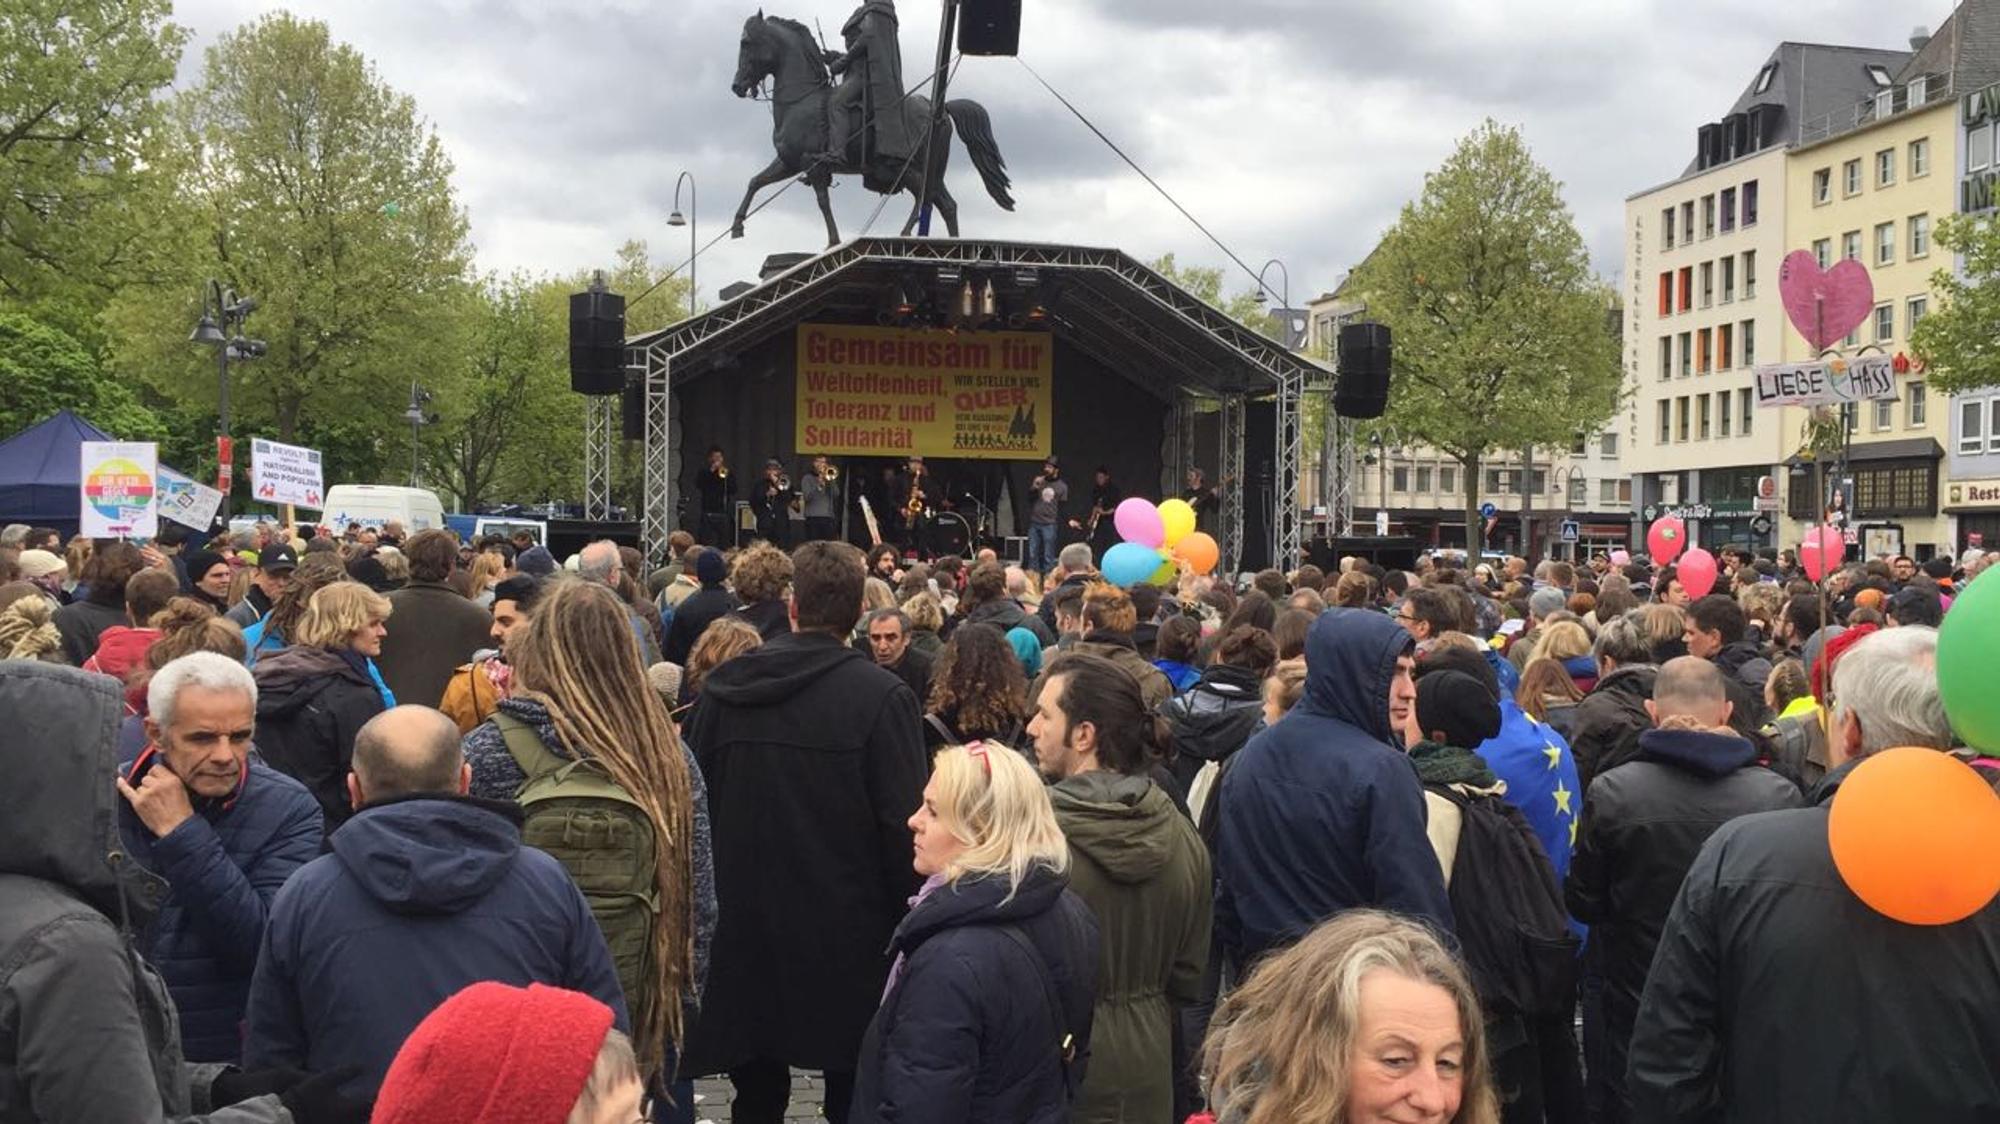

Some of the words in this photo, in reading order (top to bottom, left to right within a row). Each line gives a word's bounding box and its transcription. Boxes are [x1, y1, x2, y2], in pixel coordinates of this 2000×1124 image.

[806, 330, 990, 369] Gemeinsam
[1002, 338, 1042, 371] für
[806, 371, 948, 398] Weltoffenheit,
[953, 375, 974, 386] WIR
[976, 375, 1017, 388] STELLEN
[1020, 376, 1040, 388] UNS
[1757, 369, 1824, 400] LIEBE
[1850, 363, 1892, 396] HASS
[806, 398, 892, 422] Toleranz
[899, 402, 936, 423] und
[954, 387, 1027, 412] QUER
[805, 424, 913, 449] Solidarität
[262, 471, 280, 480] AND
[281, 474, 320, 487] POPULISM
[263, 461, 316, 476] NATIONALISM
